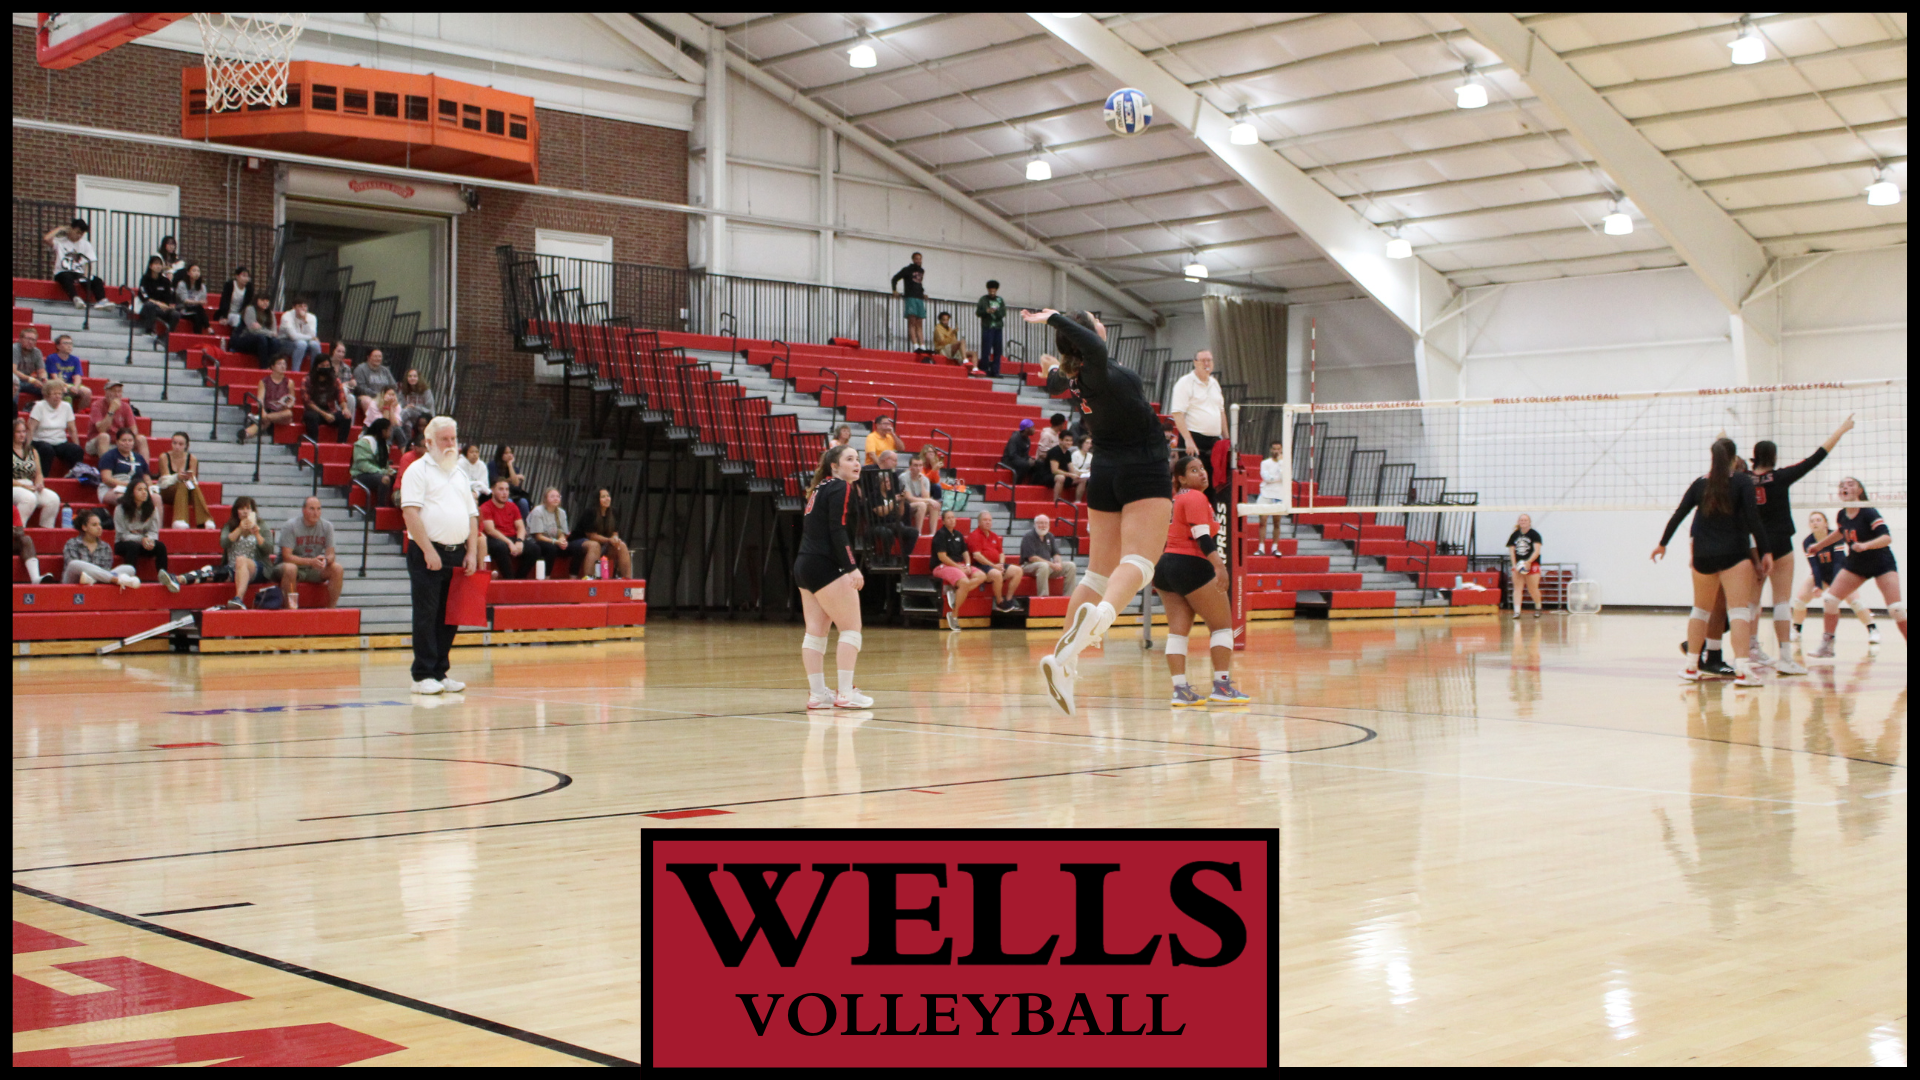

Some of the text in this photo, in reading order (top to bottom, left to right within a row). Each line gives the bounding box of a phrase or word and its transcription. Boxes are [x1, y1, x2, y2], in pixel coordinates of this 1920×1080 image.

[1698, 382, 1844, 396] WELLS COLLEGE VOLLEYBALL
[1564, 393, 1619, 402] VOLLEYBALL
[1376, 401, 1424, 409] VOLLEYBALL
[1216, 502, 1227, 565] PRESS
